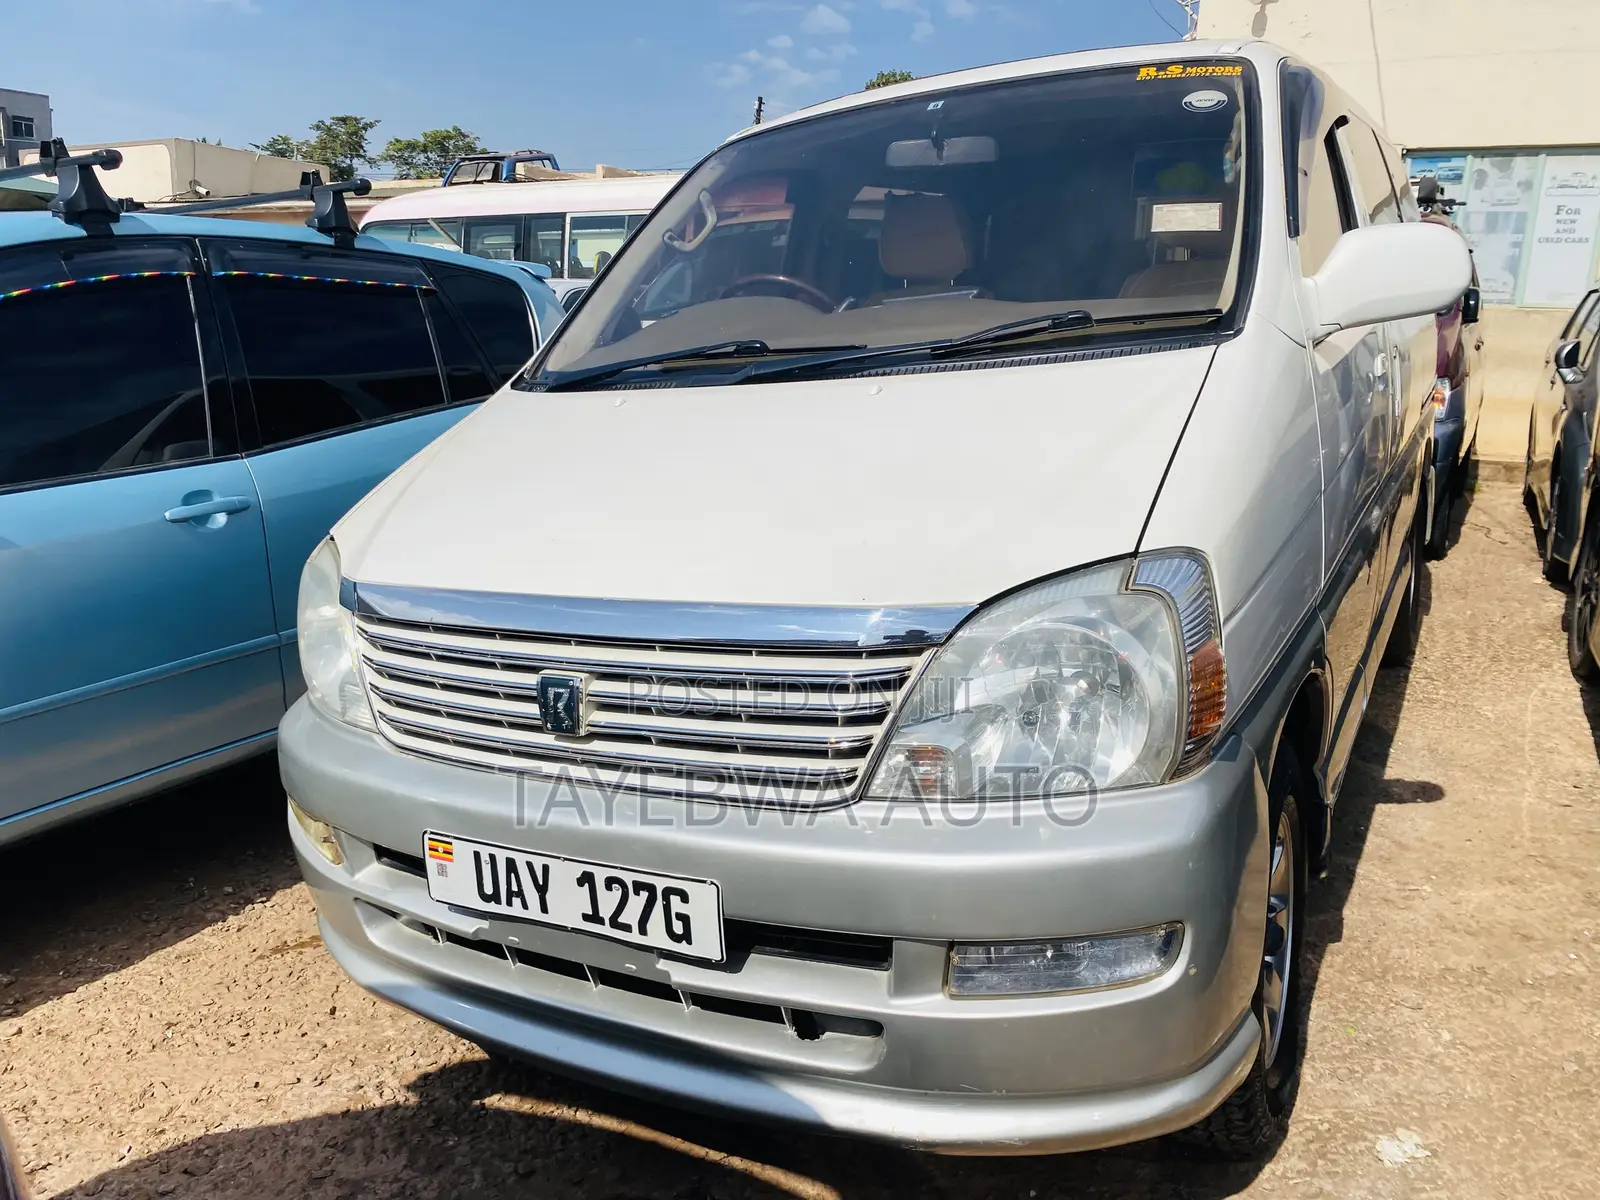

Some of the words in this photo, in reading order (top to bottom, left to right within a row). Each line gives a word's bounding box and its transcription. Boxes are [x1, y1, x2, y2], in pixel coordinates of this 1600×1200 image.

[1185, 66, 1243, 74] MOTORS
[1554, 227, 1577, 235] AND
[1537, 236, 1563, 244] USED
[1564, 236, 1591, 244] CARS
[473, 850, 550, 915] UAY
[576, 870, 694, 946] 127G
